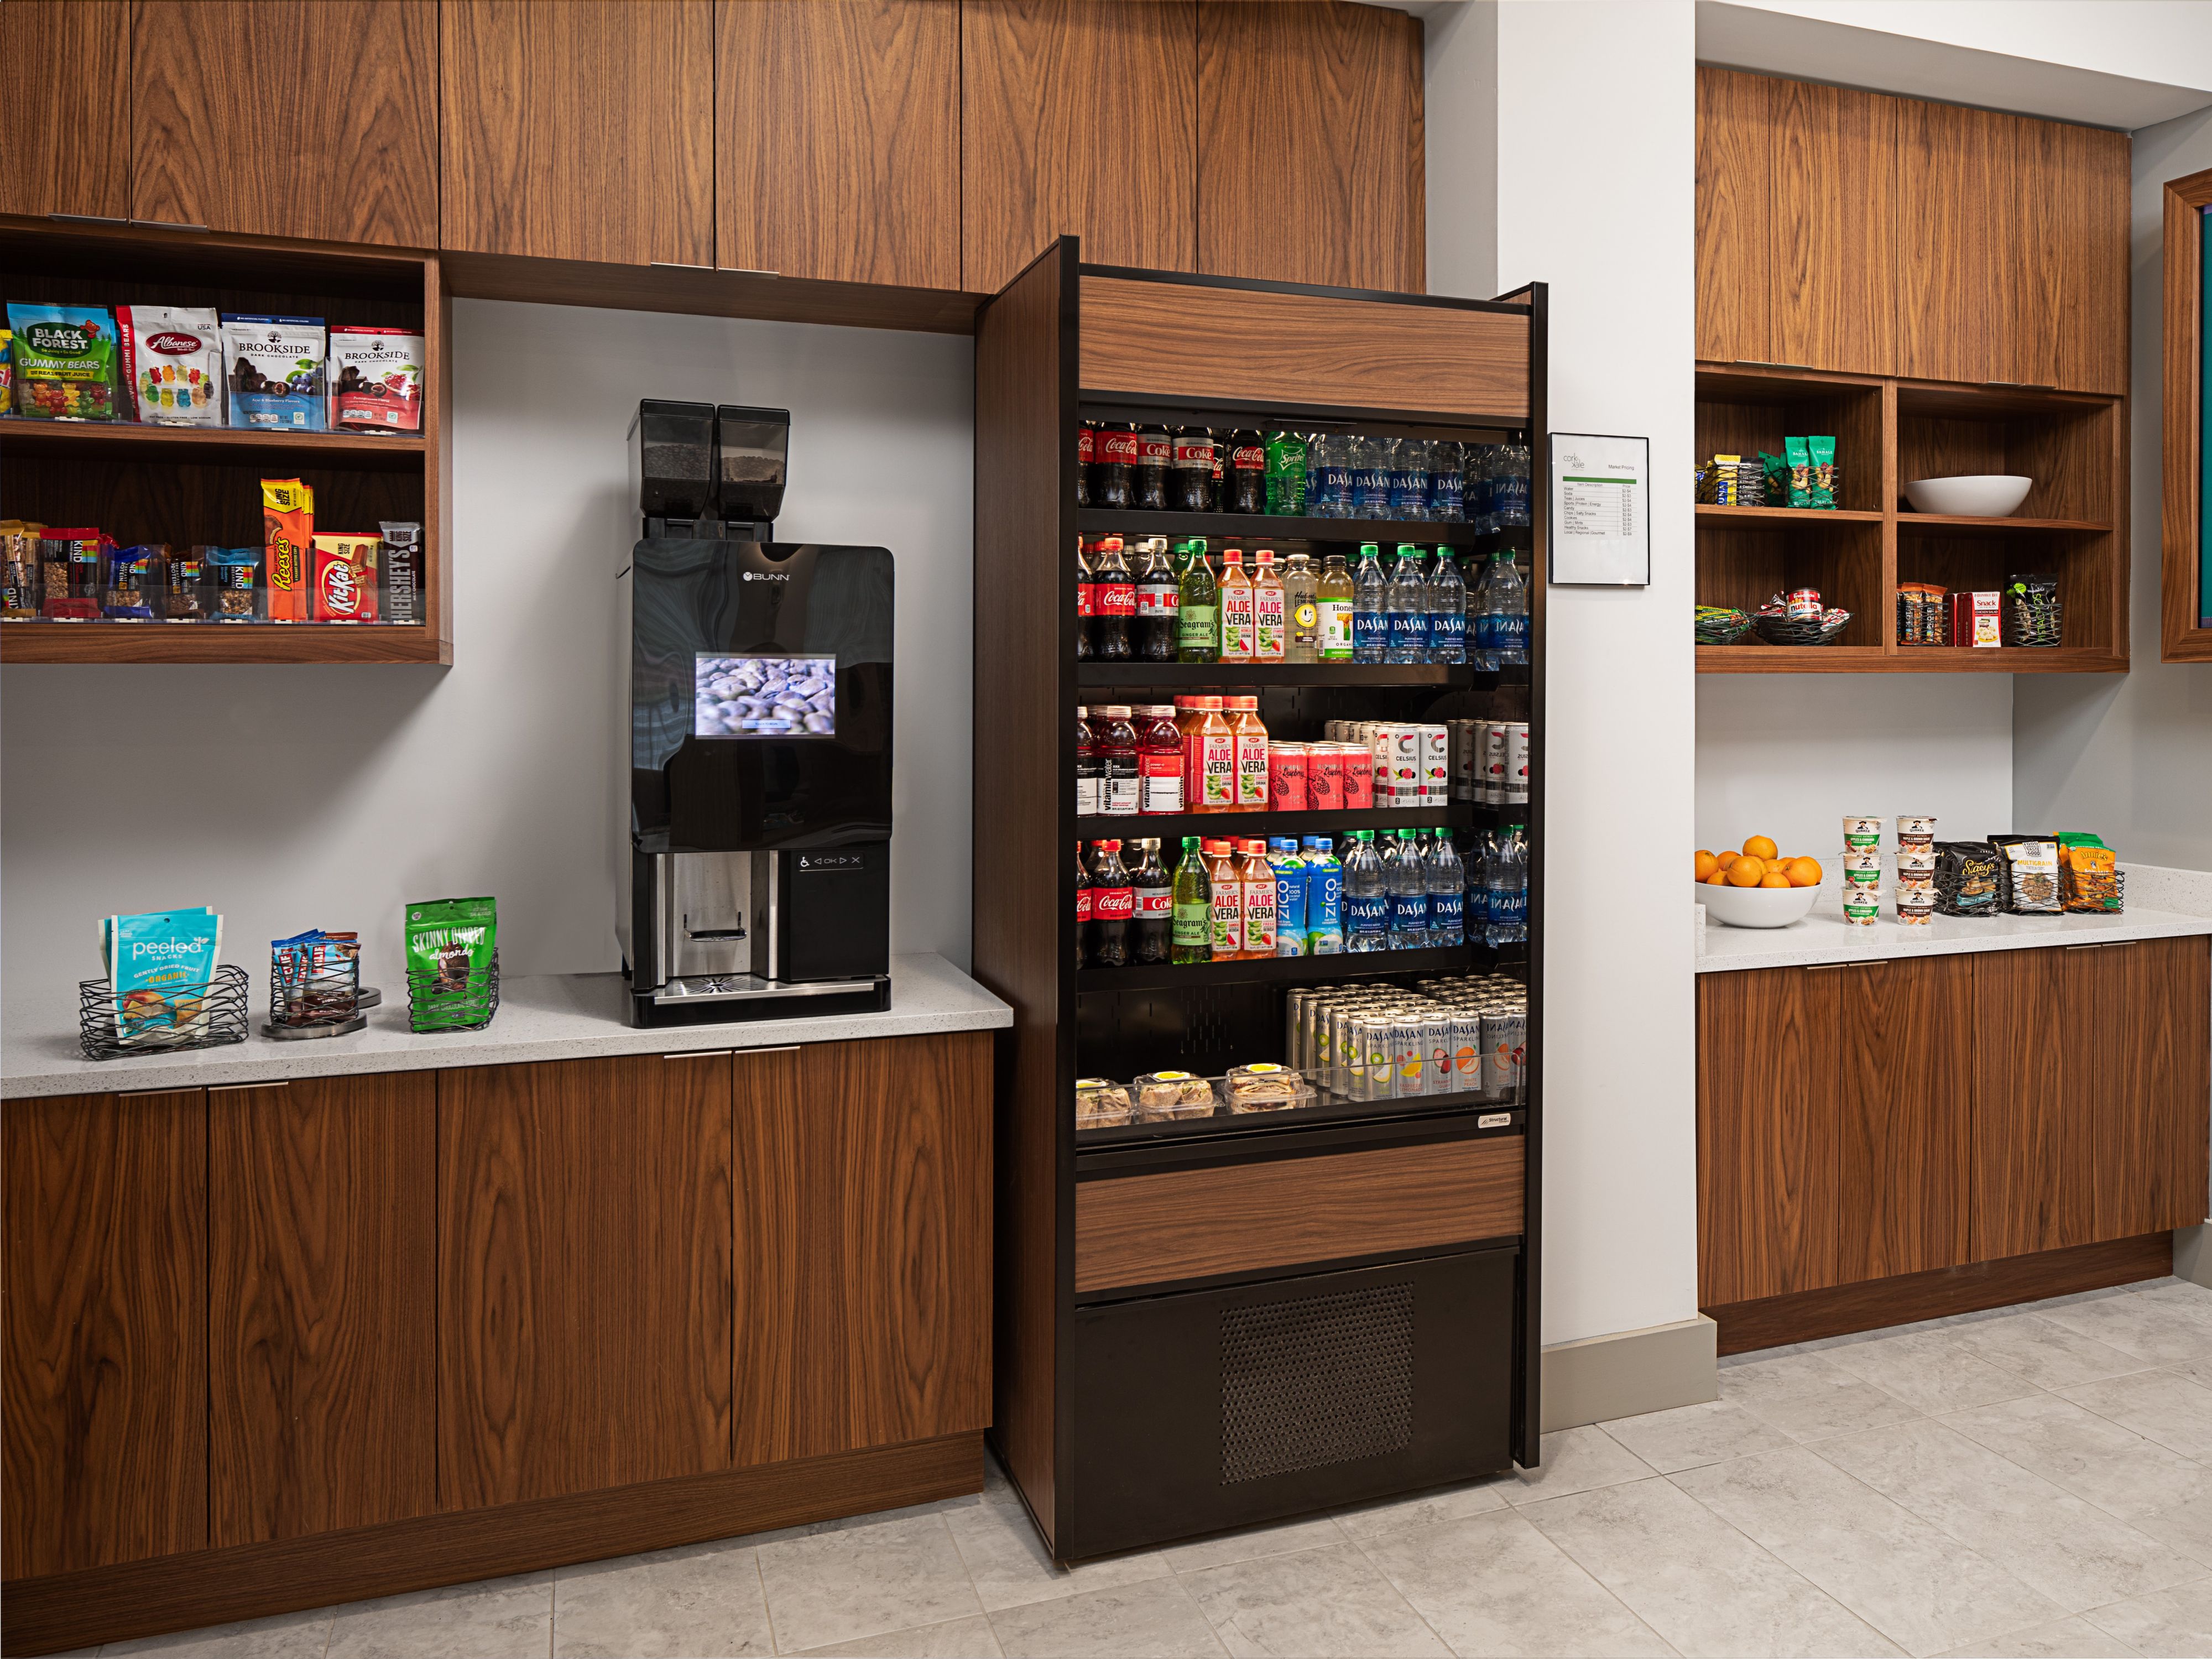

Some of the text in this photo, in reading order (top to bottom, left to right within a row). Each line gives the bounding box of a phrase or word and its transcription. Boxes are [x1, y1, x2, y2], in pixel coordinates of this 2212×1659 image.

[35, 328, 83, 340] BLACK
[32, 338, 87, 349] FOREST
[151, 336, 197, 349] Albanese
[239, 343, 310, 354] BROOKSIDE
[345, 351, 410, 360] BROOKSIDE
[19, 358, 100, 369] GUMMY BEARS
[1146, 444, 1171, 457] Coke
[1186, 448, 1212, 460] Coke
[1281, 453, 1304, 463] Sprite
[275, 489, 283, 505] KING
[282, 489, 290, 506] SIZE
[395, 531, 403, 541] KING
[73, 540, 83, 562] KIND
[272, 537, 292, 591] Reese's
[235, 566, 244, 589] KIND
[388, 550, 413, 619] HERSHEY'S
[1227, 601, 1250, 612] ALOE
[1259, 602, 1282, 613] ALOE
[1180, 619, 1215, 630] Seagram's
[1225, 612, 1251, 625] VERA
[1257, 612, 1282, 626] VERA
[1208, 749, 1231, 761] ALOE
[1242, 749, 1265, 760] ALOE
[1206, 761, 1232, 774] VERA
[1240, 760, 1265, 773] VERA
[2080, 851, 2108, 861] Annie's
[1963, 859, 1995, 877] Stacy's
[1215, 895, 1238, 907] ALOE
[1249, 895, 1273, 906] ALOE
[1277, 880, 1290, 920] ZICO
[1326, 878, 1337, 917] ZICO
[1213, 907, 1239, 920] VERA
[1247, 906, 1274, 920] VERA
[412, 927, 486, 953] SKINNY DIPPED
[133, 937, 201, 961] peeled
[429, 943, 474, 960] almonds
[134, 967, 158, 978] GENTLY
[1395, 1028, 1423, 1041] DASANI
